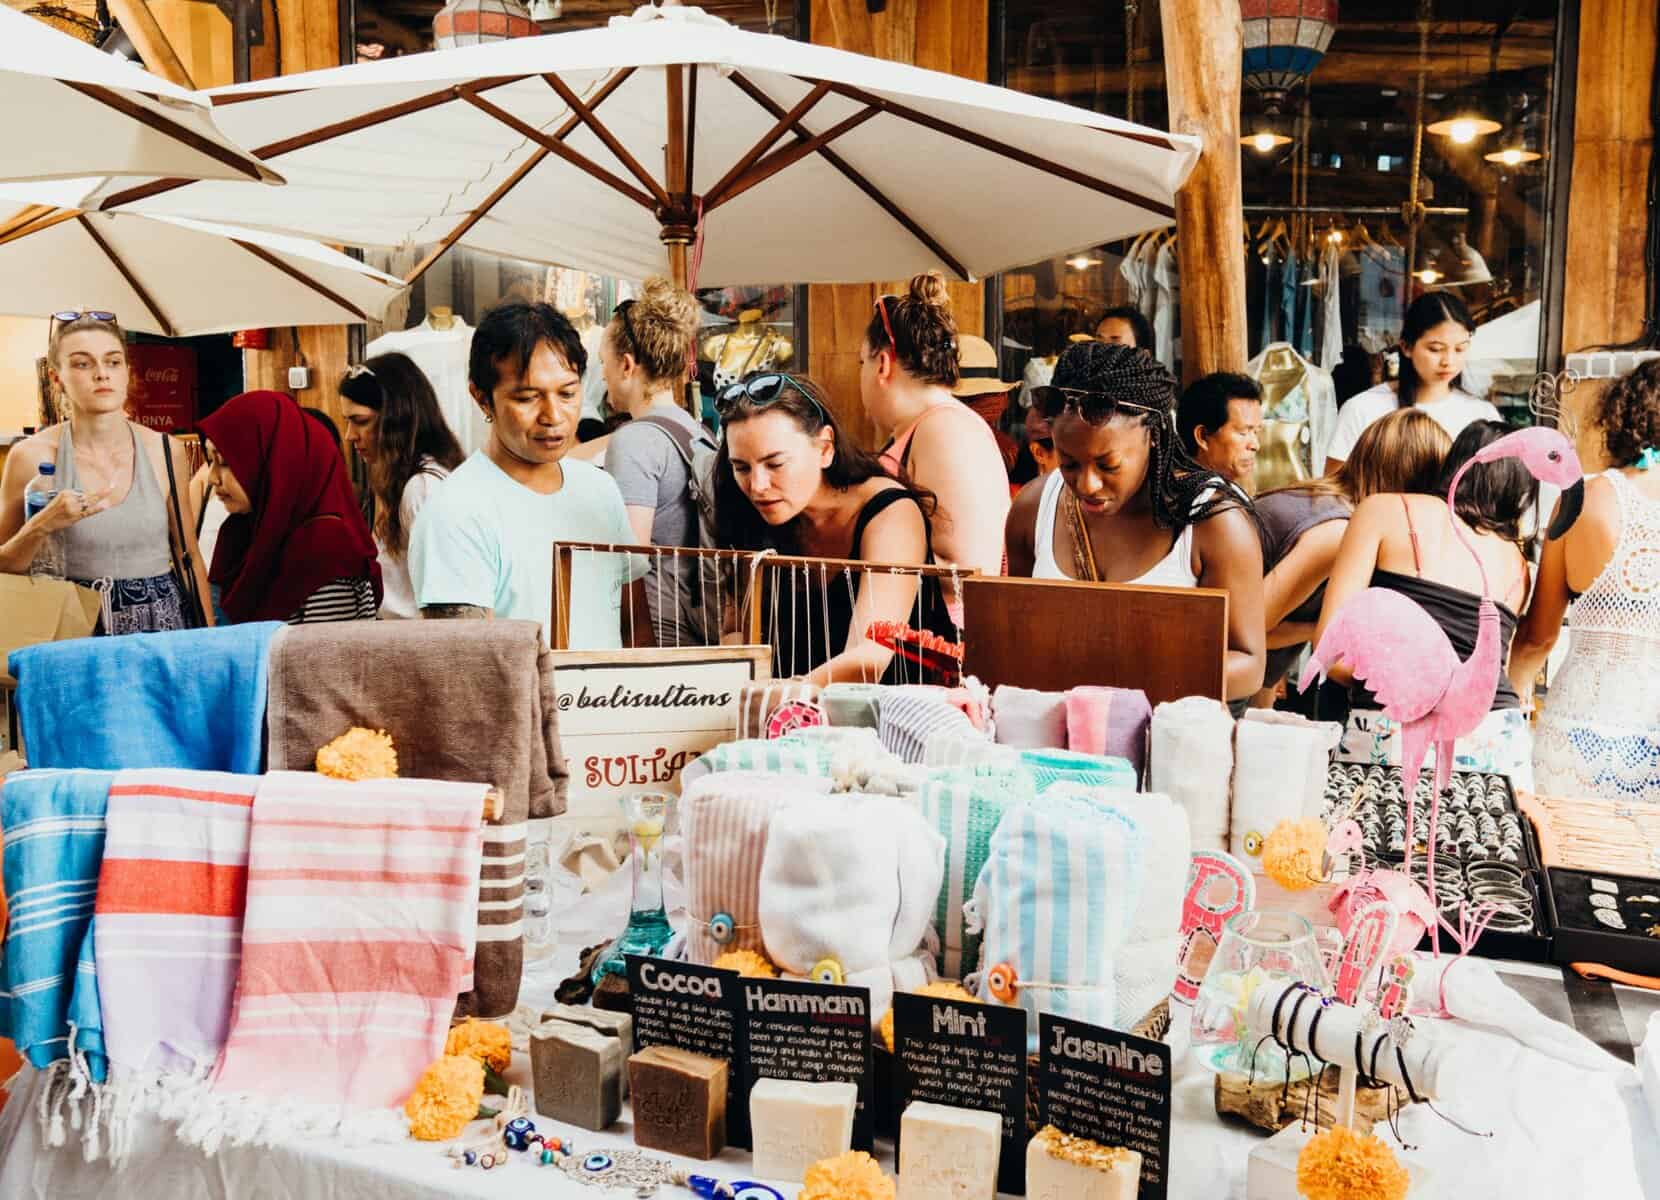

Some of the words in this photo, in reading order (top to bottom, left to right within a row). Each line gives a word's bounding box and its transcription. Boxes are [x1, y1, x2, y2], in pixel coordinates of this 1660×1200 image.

[558, 684, 732, 711] @balisultans
[640, 962, 723, 999] Cocoa
[745, 985, 864, 1015] Hammam
[932, 1003, 987, 1037] Mint
[1050, 1025, 1163, 1077] Jasmine
